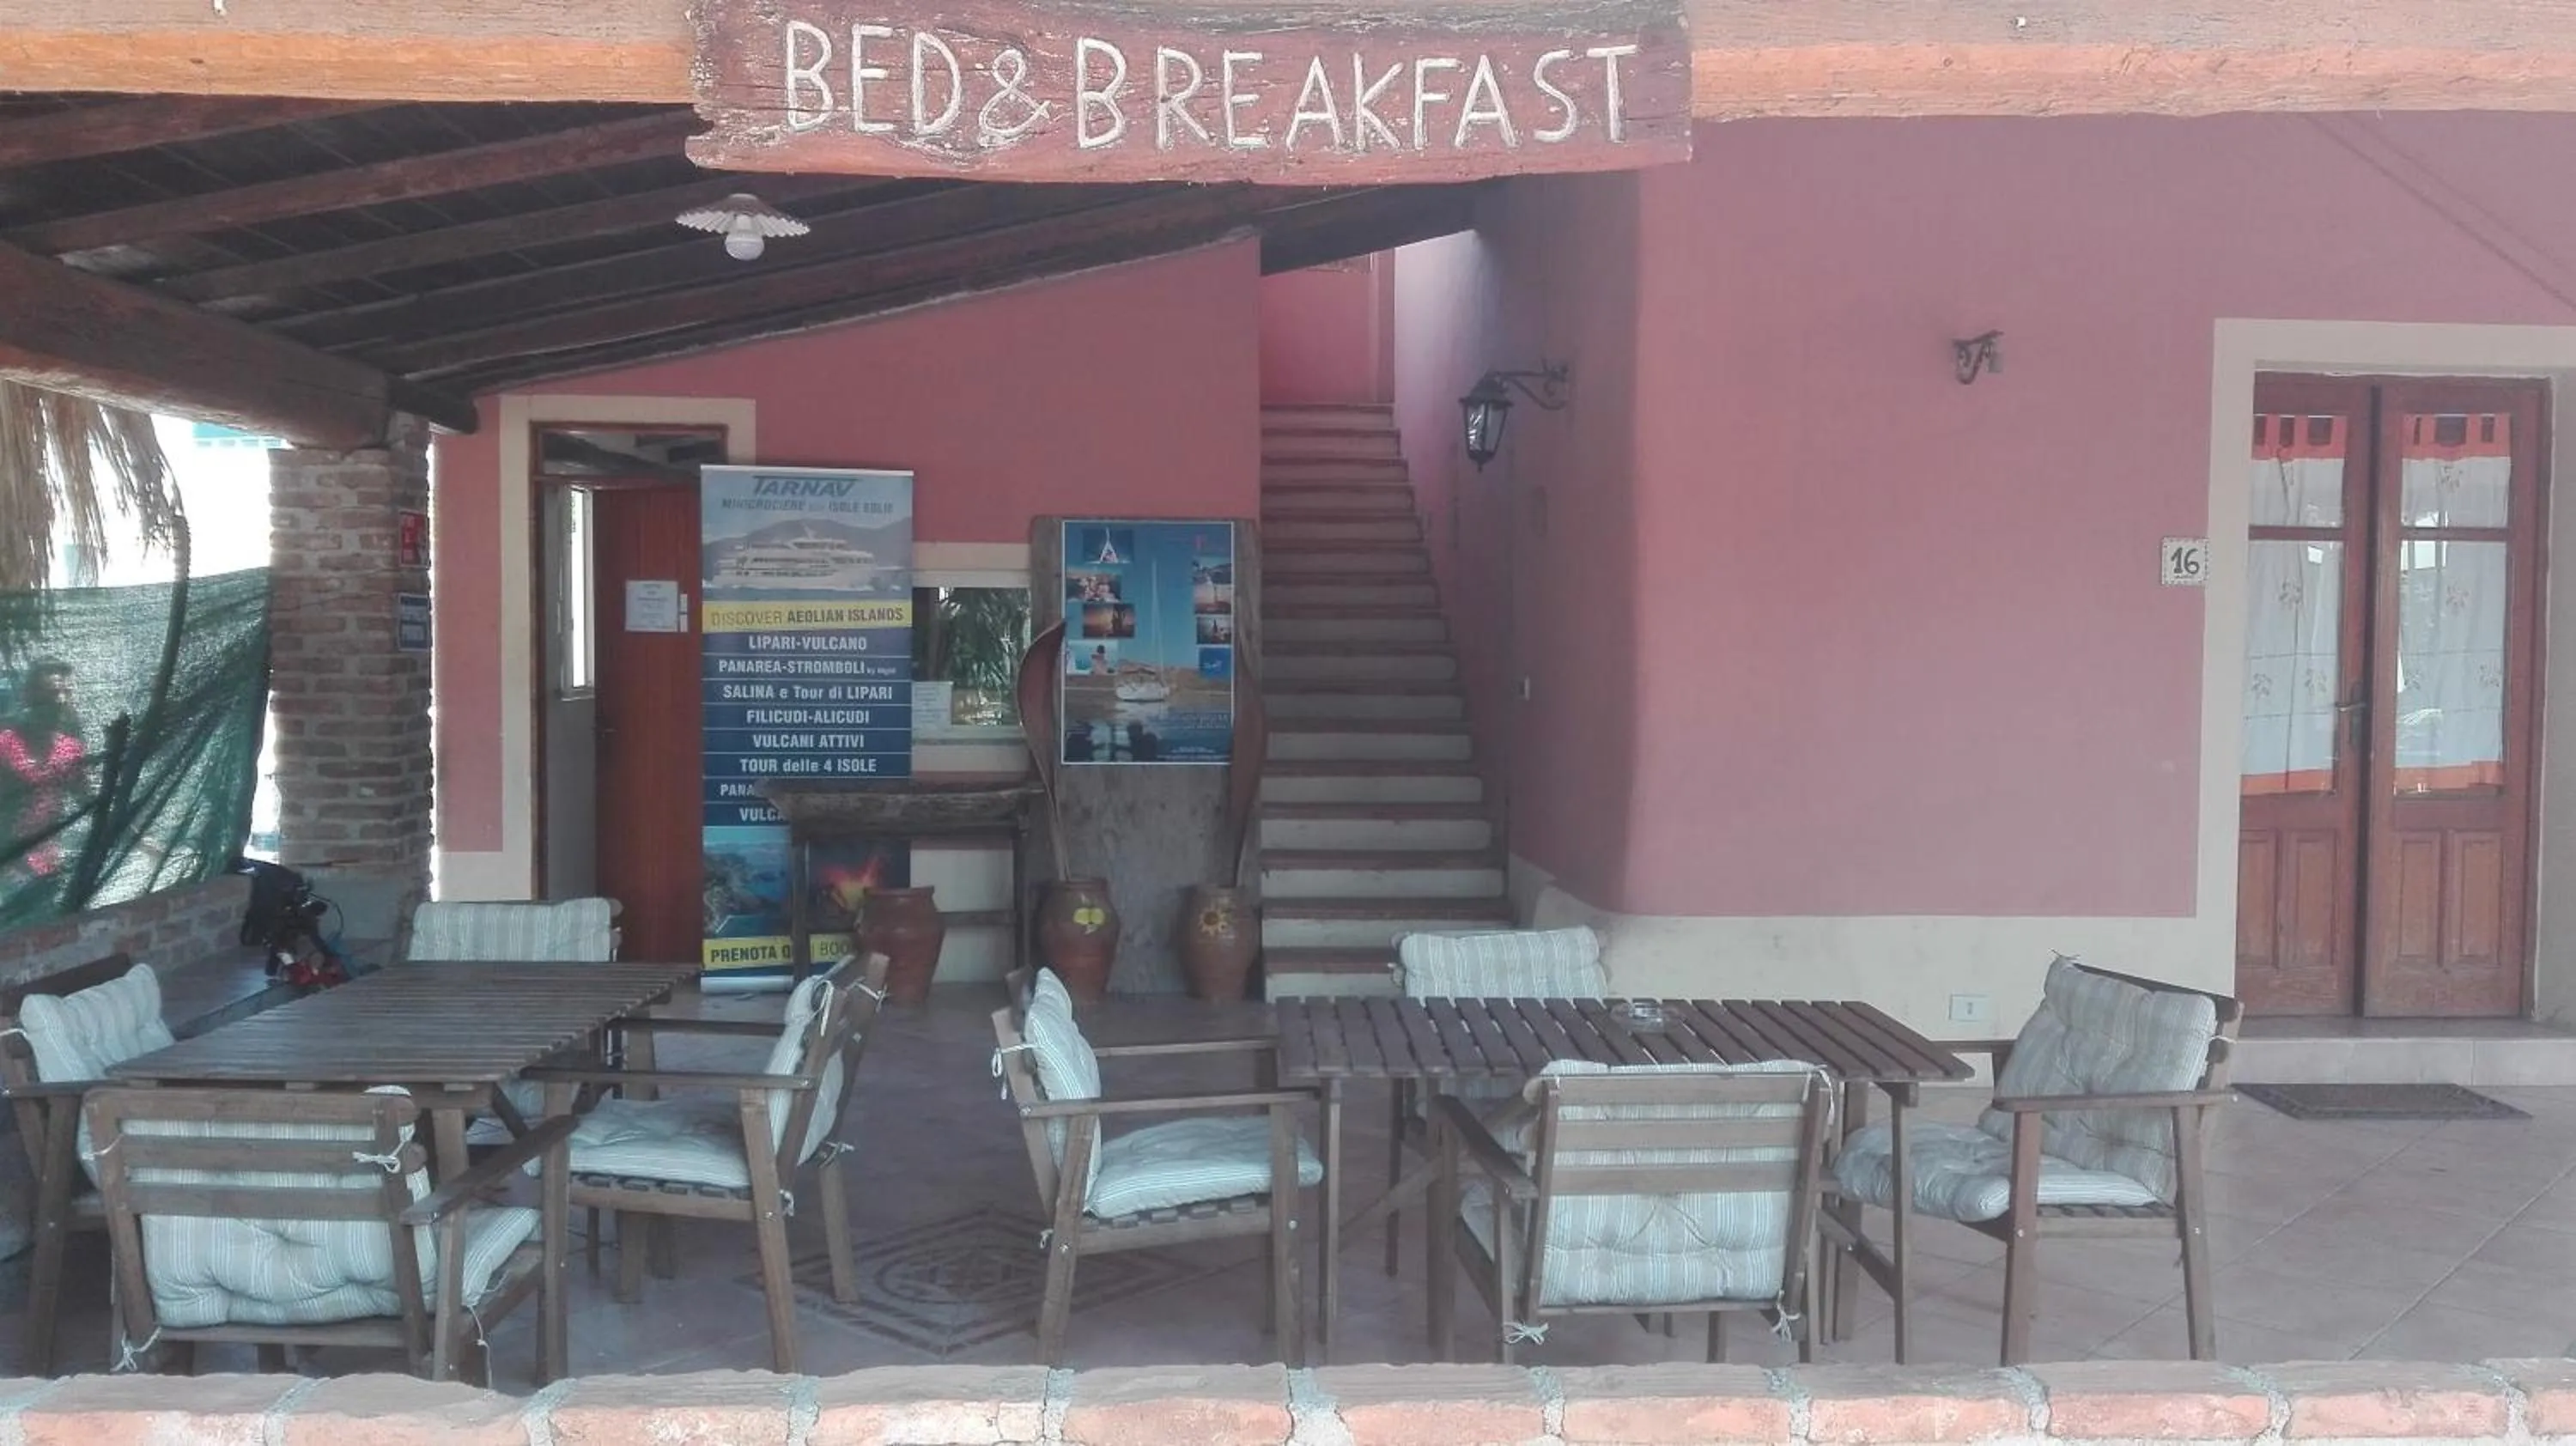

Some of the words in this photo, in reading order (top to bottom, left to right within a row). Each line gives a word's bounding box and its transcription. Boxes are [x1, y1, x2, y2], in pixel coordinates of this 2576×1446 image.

[786, 20, 963, 136] BED
[978, 48, 1053, 139] &
[1075, 36, 1637, 150] BREAKFAST
[752, 475, 862, 497] TARNAV
[2171, 547, 2200, 574] 16
[711, 610, 782, 627] DISCOVER
[787, 608, 844, 624] AEOLIAN
[848, 606, 904, 623] ISLANDS
[748, 635, 867, 651] LIPARI-VULCANO
[719, 659, 865, 675] PANAREA-STROMBOLI
[722, 685, 774, 700] SALINA
[779, 688, 788, 700] e
[794, 686, 823, 700] Tour
[829, 685, 843, 700] di
[847, 685, 892, 701] LIPARI
[746, 709, 870, 725] FILICUDI-ALICUDI
[752, 733, 814, 749] VULCANI
[818, 734, 865, 749] ATTIVI
[739, 758, 778, 773] TOUR
[782, 758, 819, 773] delle
[823, 758, 833, 772] 4
[837, 758, 877, 773] ISOLE
[720, 783, 756, 798] PANA
[710, 945, 778, 963] PRENOTA
[820, 940, 850, 957] BOO
